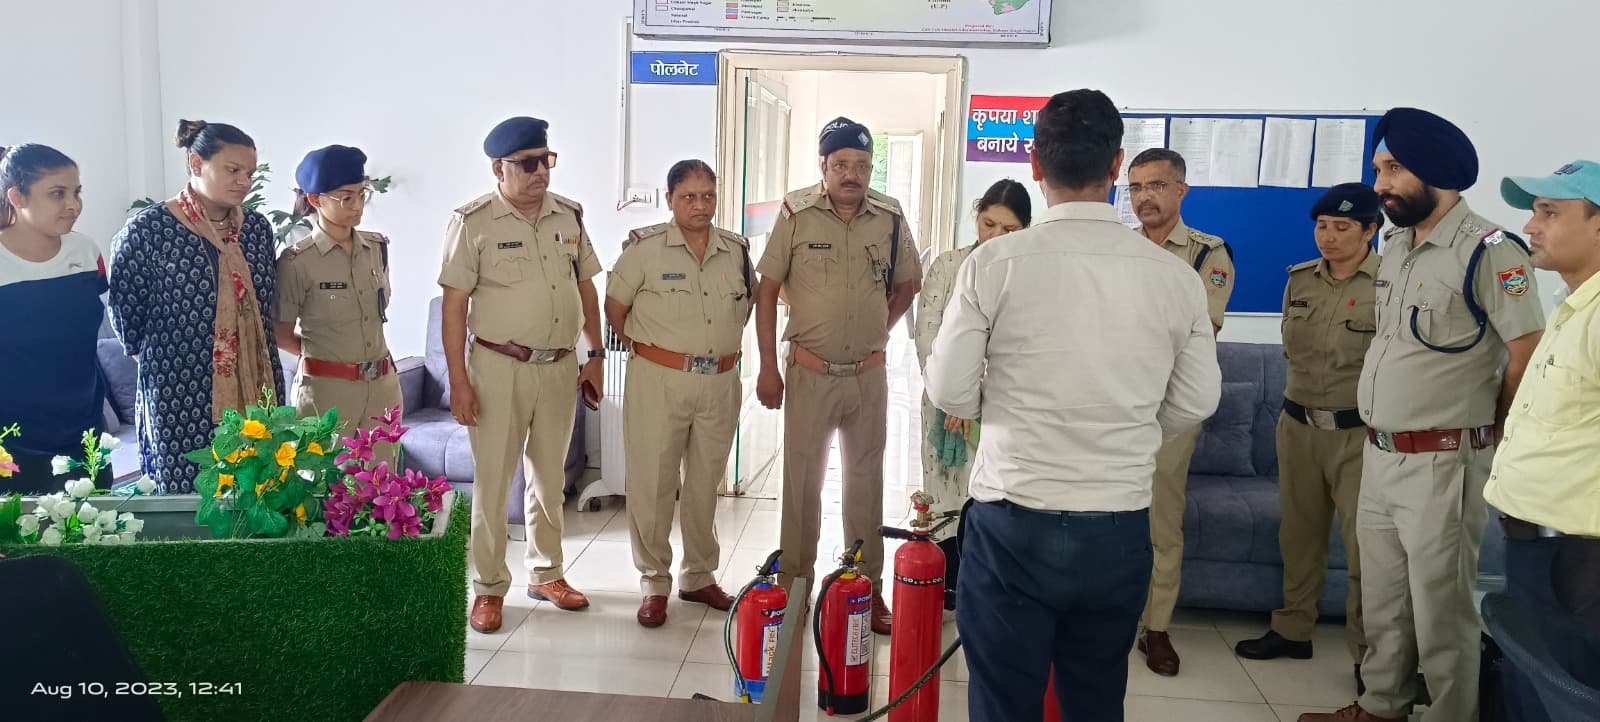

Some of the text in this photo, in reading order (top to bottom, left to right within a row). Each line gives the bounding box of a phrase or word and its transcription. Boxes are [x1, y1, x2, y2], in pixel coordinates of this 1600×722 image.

[649, 59, 699, 76] पोलनेट
[971, 108, 1018, 131] कृपया
[976, 132, 1019, 153] बनाये
